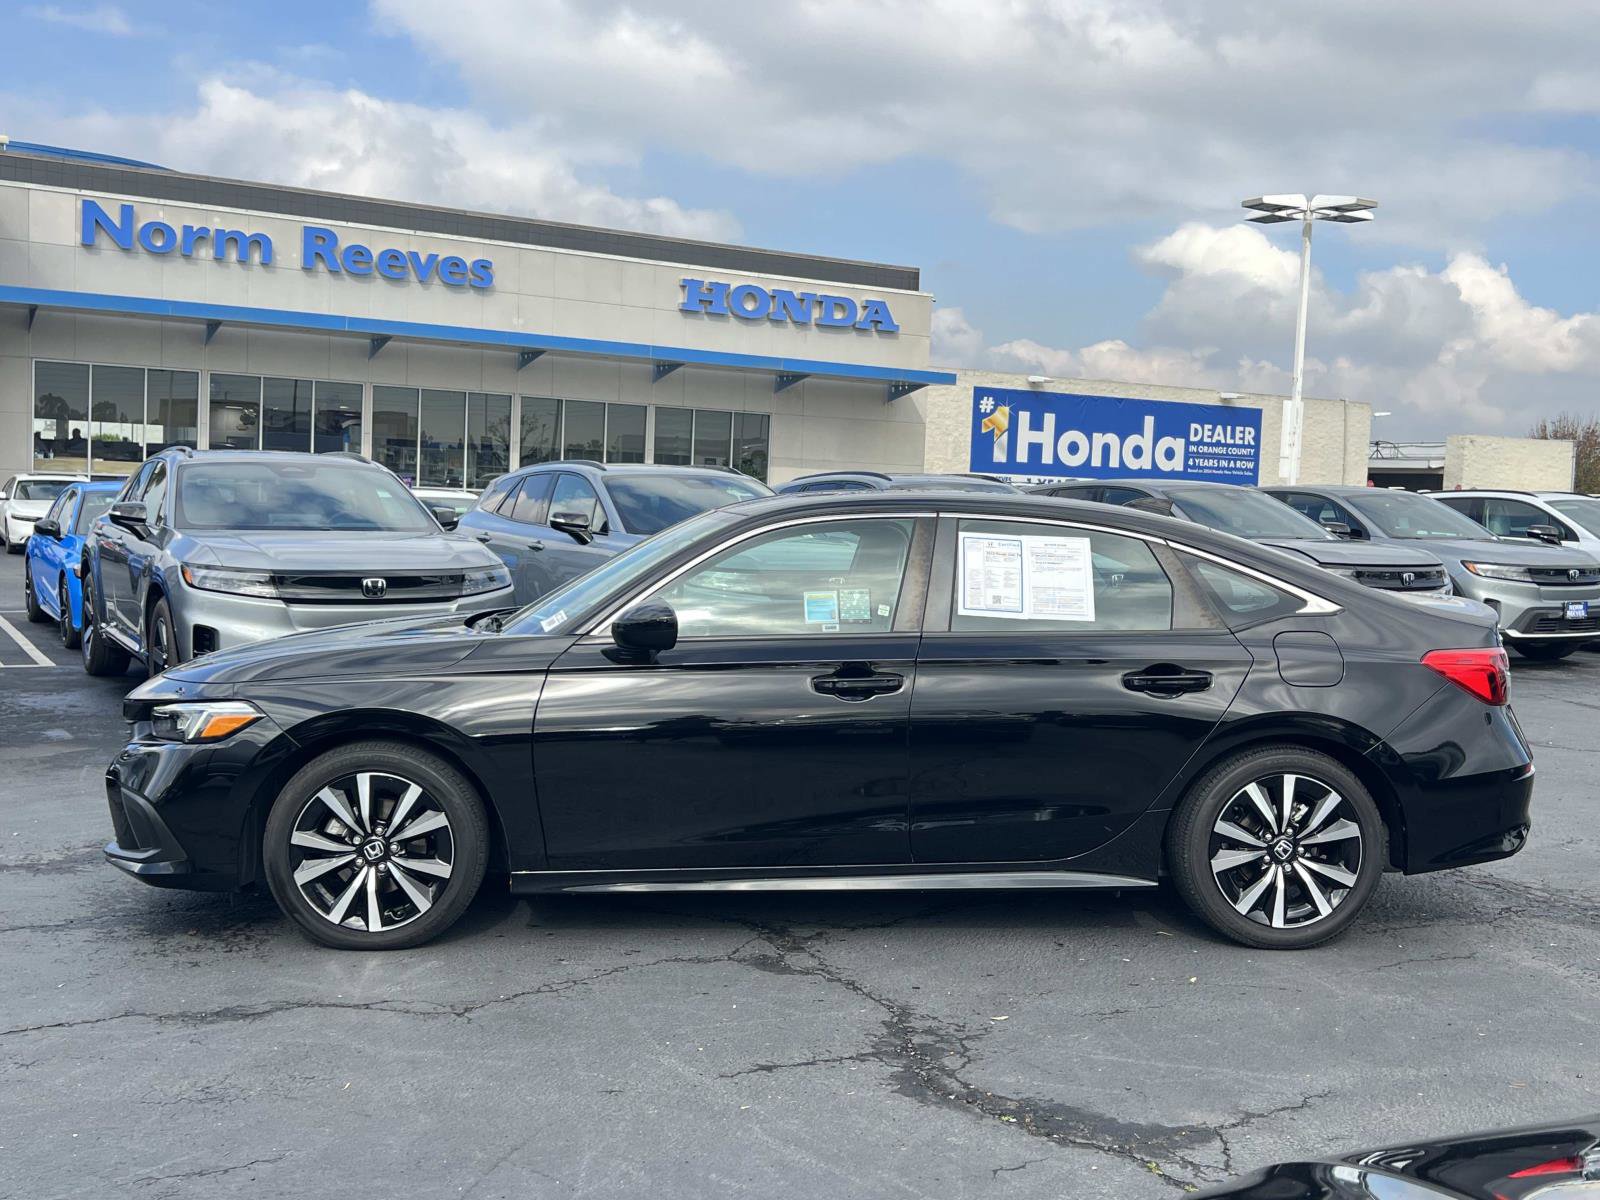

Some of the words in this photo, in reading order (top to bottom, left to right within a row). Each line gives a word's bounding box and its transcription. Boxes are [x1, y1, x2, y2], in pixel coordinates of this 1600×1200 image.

[80, 199, 273, 266] Norm
[300, 225, 495, 290] Reeves
[679, 278, 901, 333] HONDA
[1016, 410, 1186, 472] Honda
[1189, 423, 1255, 445] DEALER
[1198, 446, 1227, 454] ORANGE
[1228, 448, 1255, 456] COUNTY
[1188, 458, 1193, 466] 4
[1194, 459, 1218, 468] YEARS
[1219, 460, 1228, 468] IN
[1229, 460, 1235, 468] A
[1236, 461, 1255, 469] ROW
